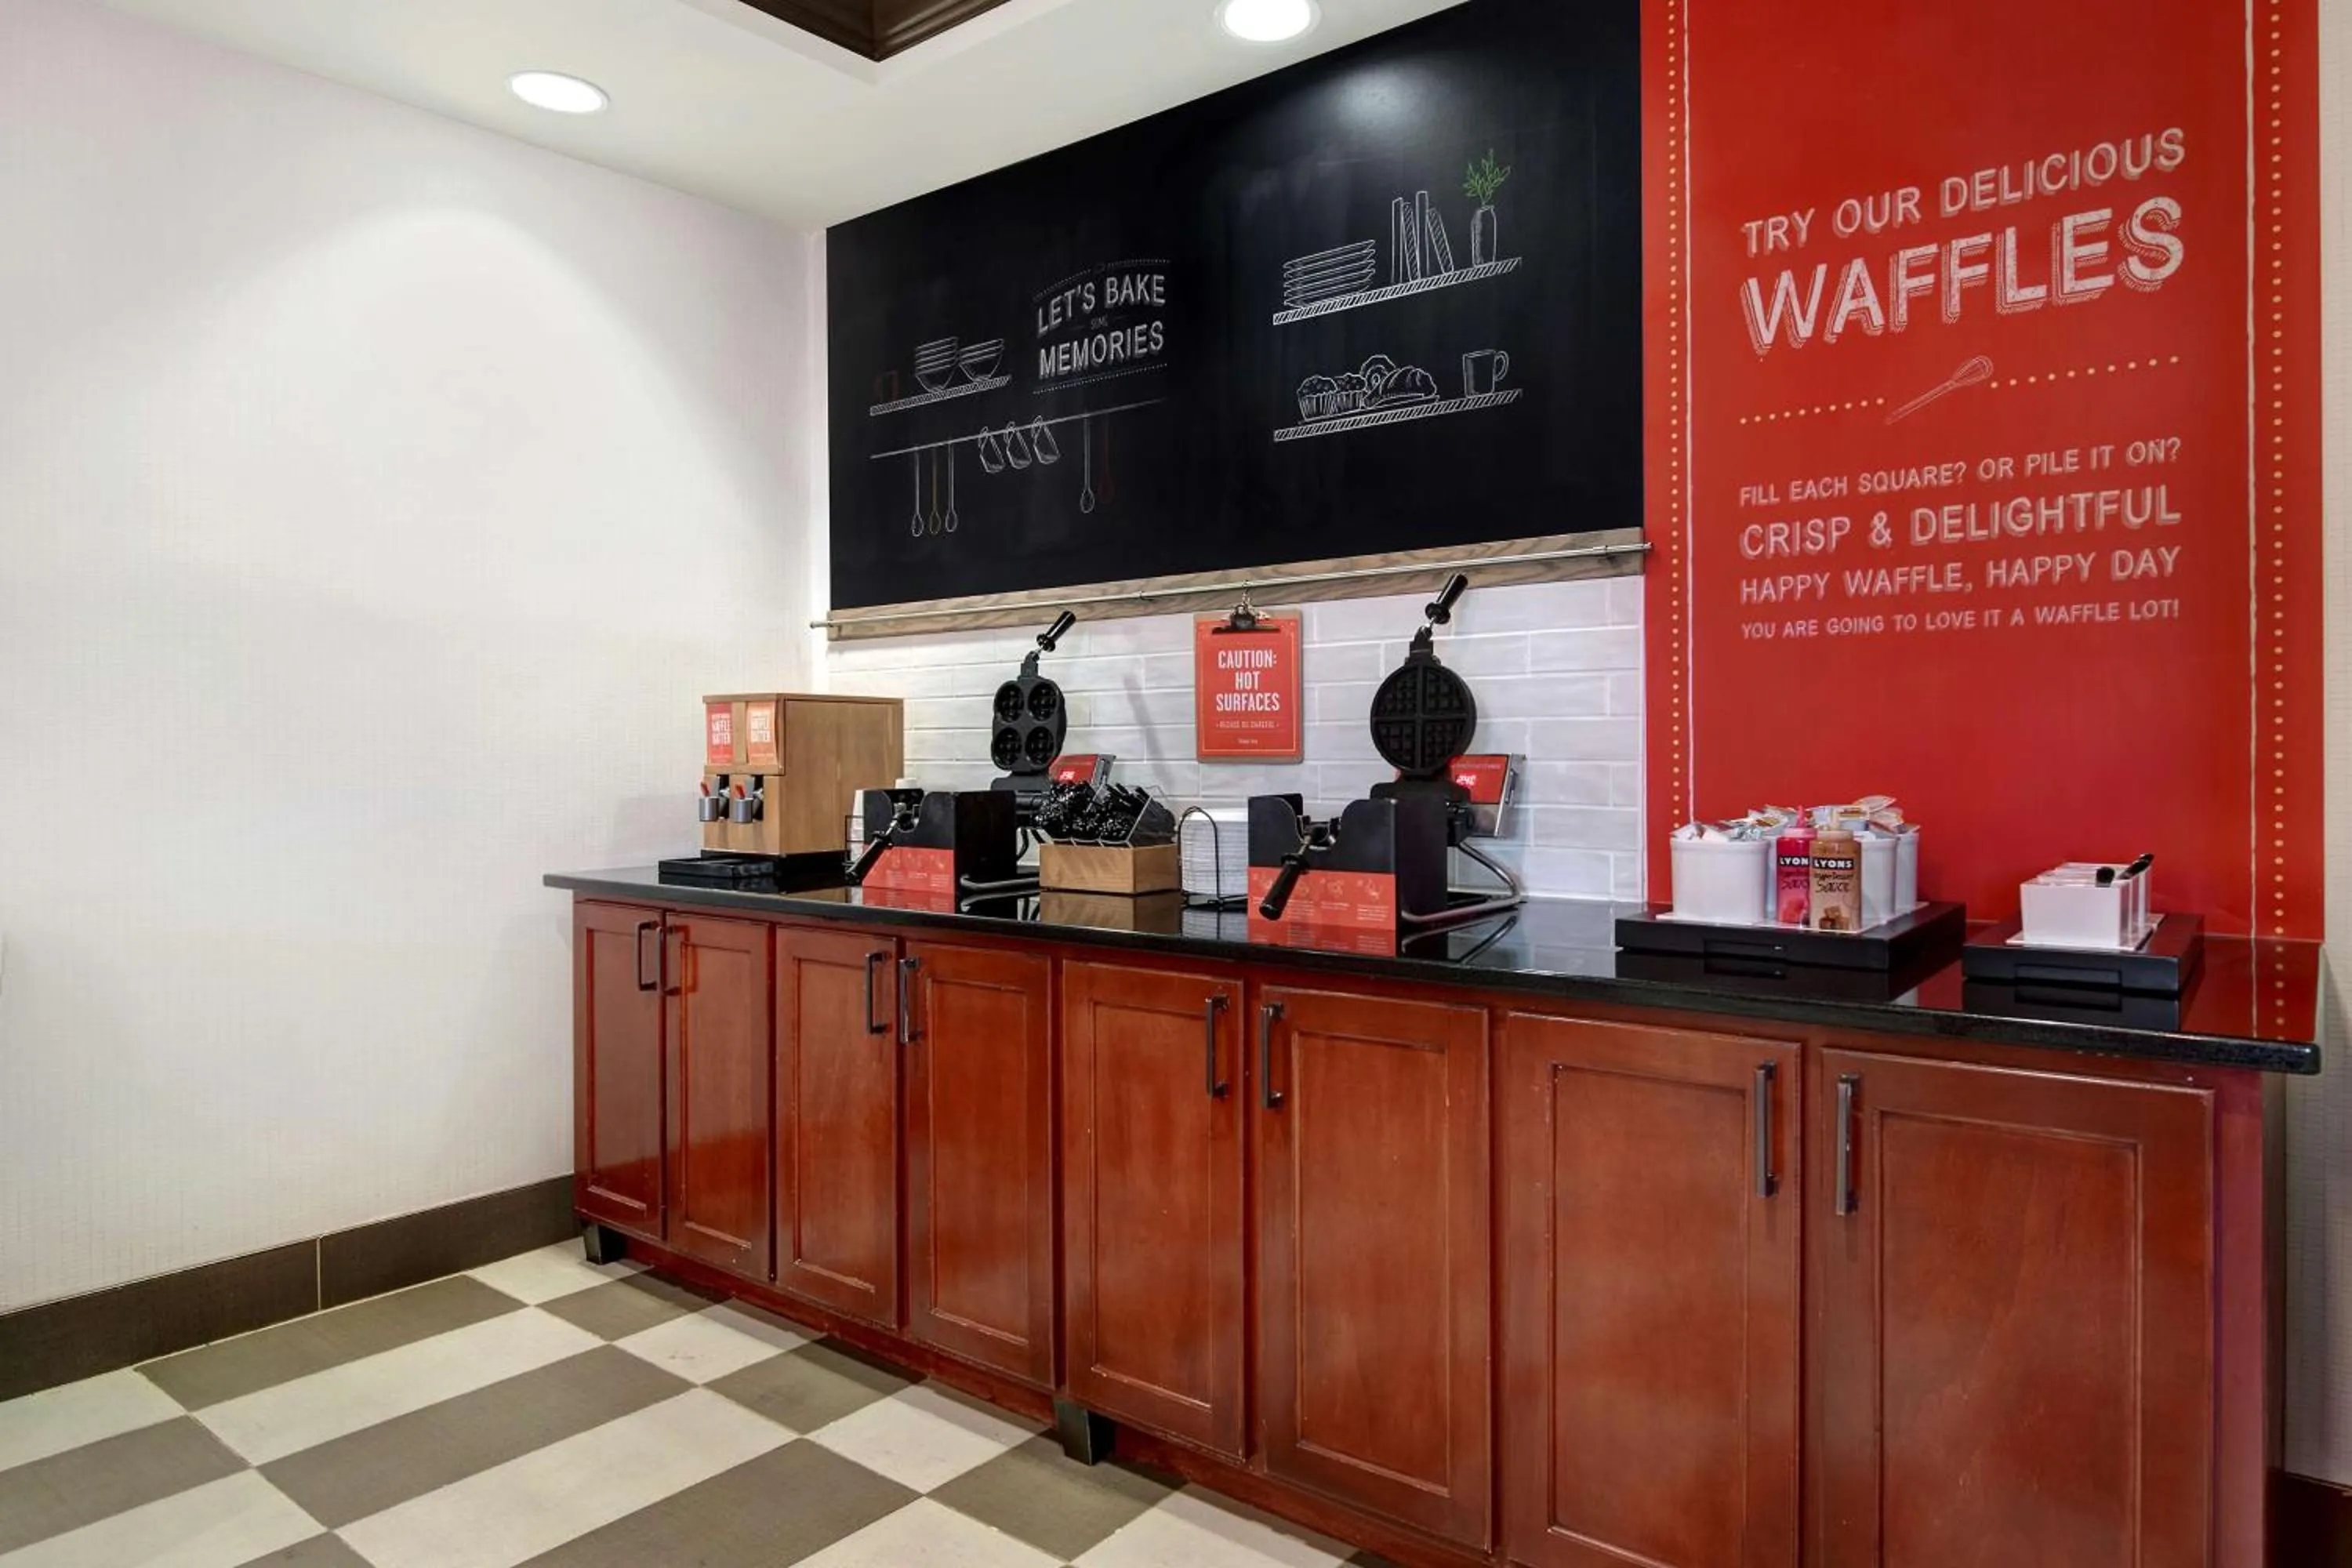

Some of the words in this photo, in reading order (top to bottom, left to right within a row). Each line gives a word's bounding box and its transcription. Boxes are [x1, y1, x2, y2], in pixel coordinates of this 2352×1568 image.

[1741, 209, 1815, 256] TRY
[1833, 186, 1922, 234] OUR
[1940, 128, 2185, 219] DELICIOUS
[1740, 196, 2184, 355] WAFFLES
[1037, 281, 1095, 337] LET'S
[1105, 274, 1166, 307] BAKE
[1039, 321, 1164, 379] MEMORIES
[1740, 484, 1780, 507] FILL
[1790, 477, 1848, 502] EACH
[1859, 461, 1966, 493] SQUARE?
[1979, 457, 2014, 481] OR
[2024, 448, 2079, 477] PILE
[2090, 445, 2114, 469] IT
[2126, 437, 2182, 466] ON?
[1740, 516, 1850, 558] CRISP
[1870, 510, 1893, 547] &
[1910, 484, 2182, 546] DELIGHTFUL
[1740, 572, 1830, 604] HAPPY
[1845, 561, 1973, 596] WAFFLE,
[1986, 552, 2096, 588] HAPPY
[2111, 546, 2182, 581] DAY
[1742, 622, 1776, 639] YOU
[1784, 619, 1819, 637] ARE
[1827, 615, 1884, 635] GOING
[1894, 613, 1916, 631] TO
[1926, 611, 1976, 630] LOVE
[1984, 609, 2002, 626] IT
[2010, 608, 2024, 625] A
[2033, 603, 2121, 623] WAFFLE
[2129, 598, 2180, 619] LOT!
[1218, 648, 1277, 669] CAUTION:
[1235, 670, 1261, 691] HOT
[1216, 692, 1280, 712] SURFACES
[1813, 859, 1853, 868] LYONS
